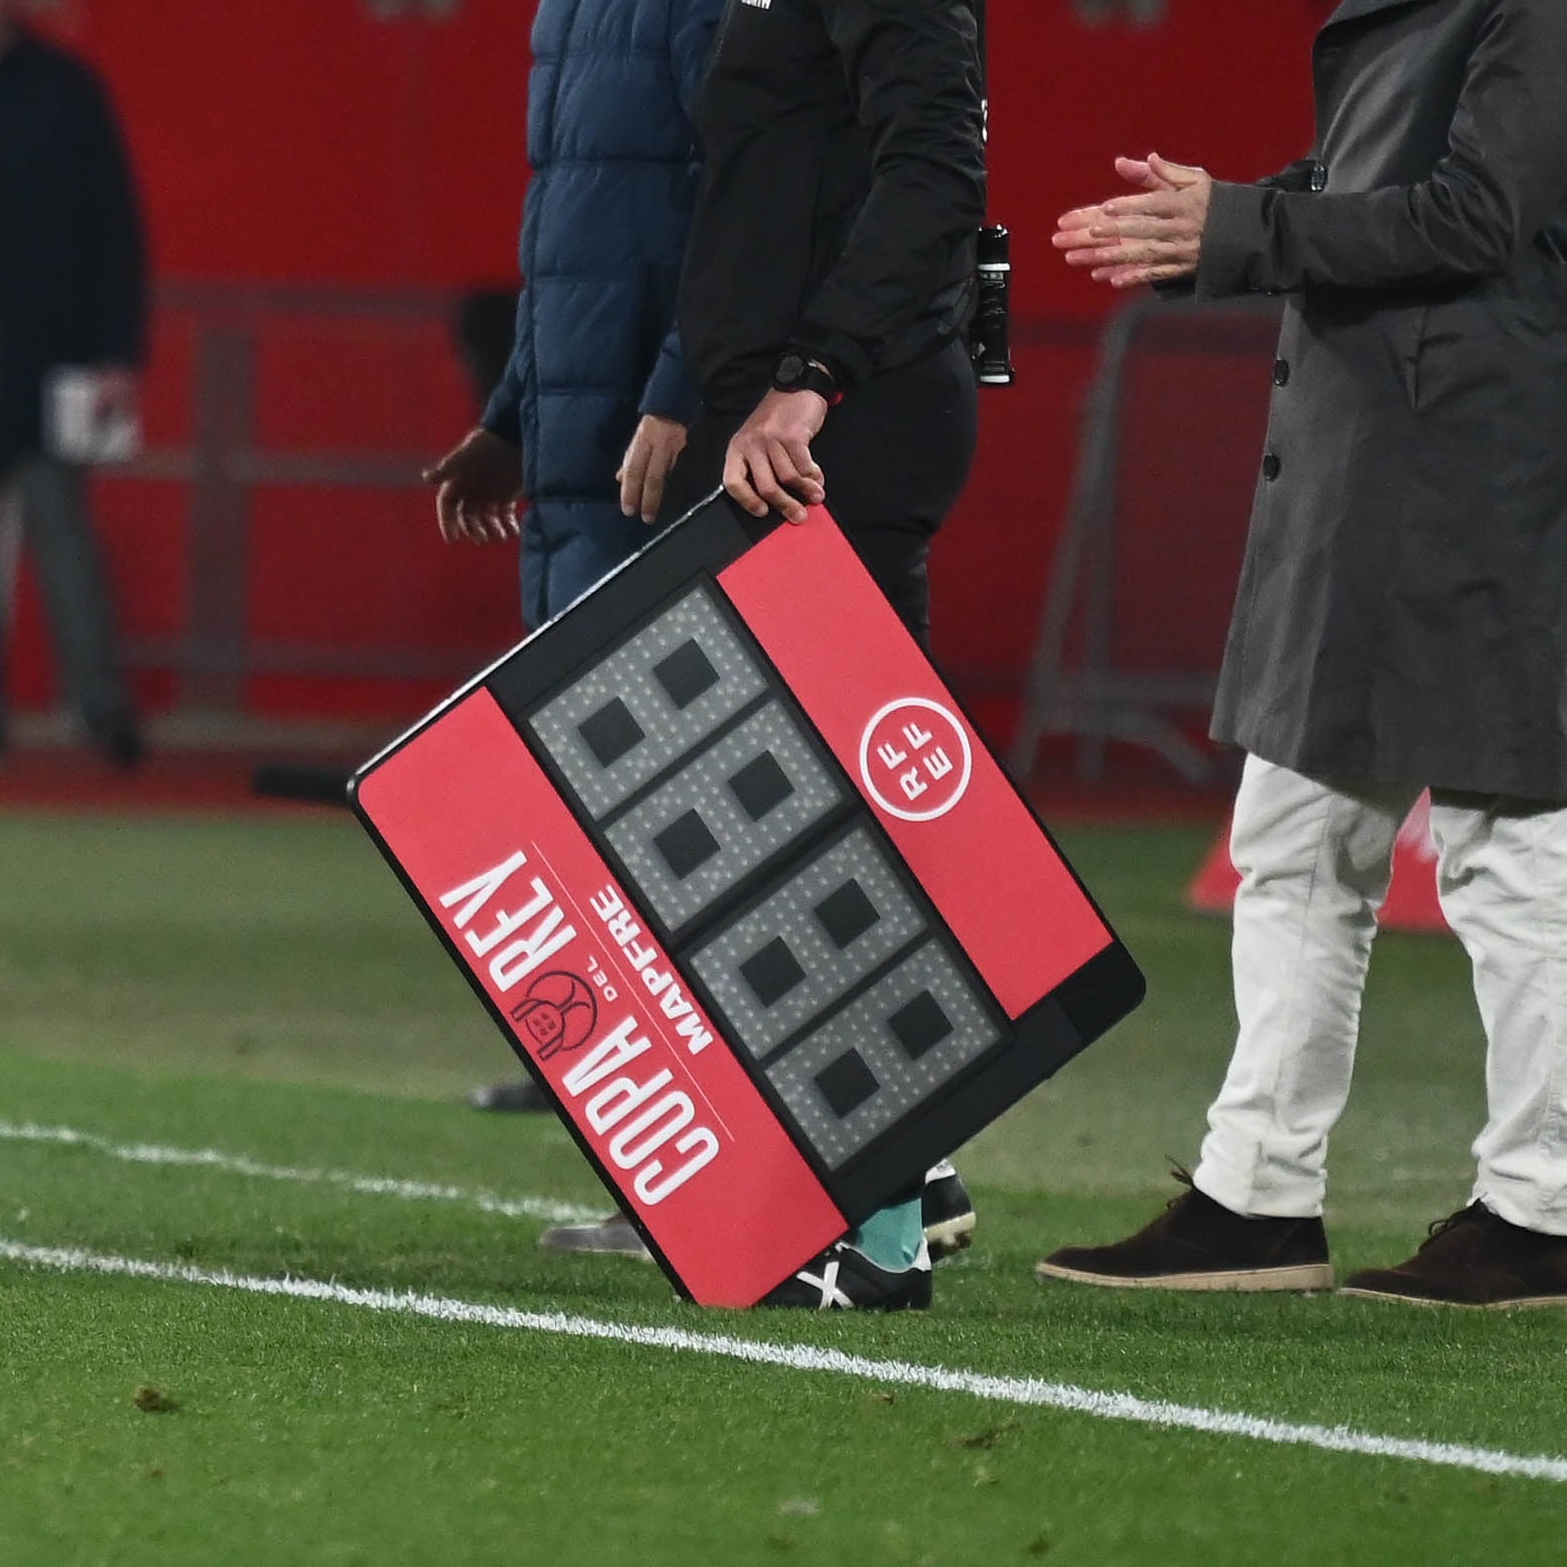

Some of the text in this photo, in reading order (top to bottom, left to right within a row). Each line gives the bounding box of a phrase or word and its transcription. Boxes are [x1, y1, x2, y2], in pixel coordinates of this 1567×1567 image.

[438, 849, 720, 1206] COPA DEL REY
[589, 883, 714, 1056] MAPFRE
